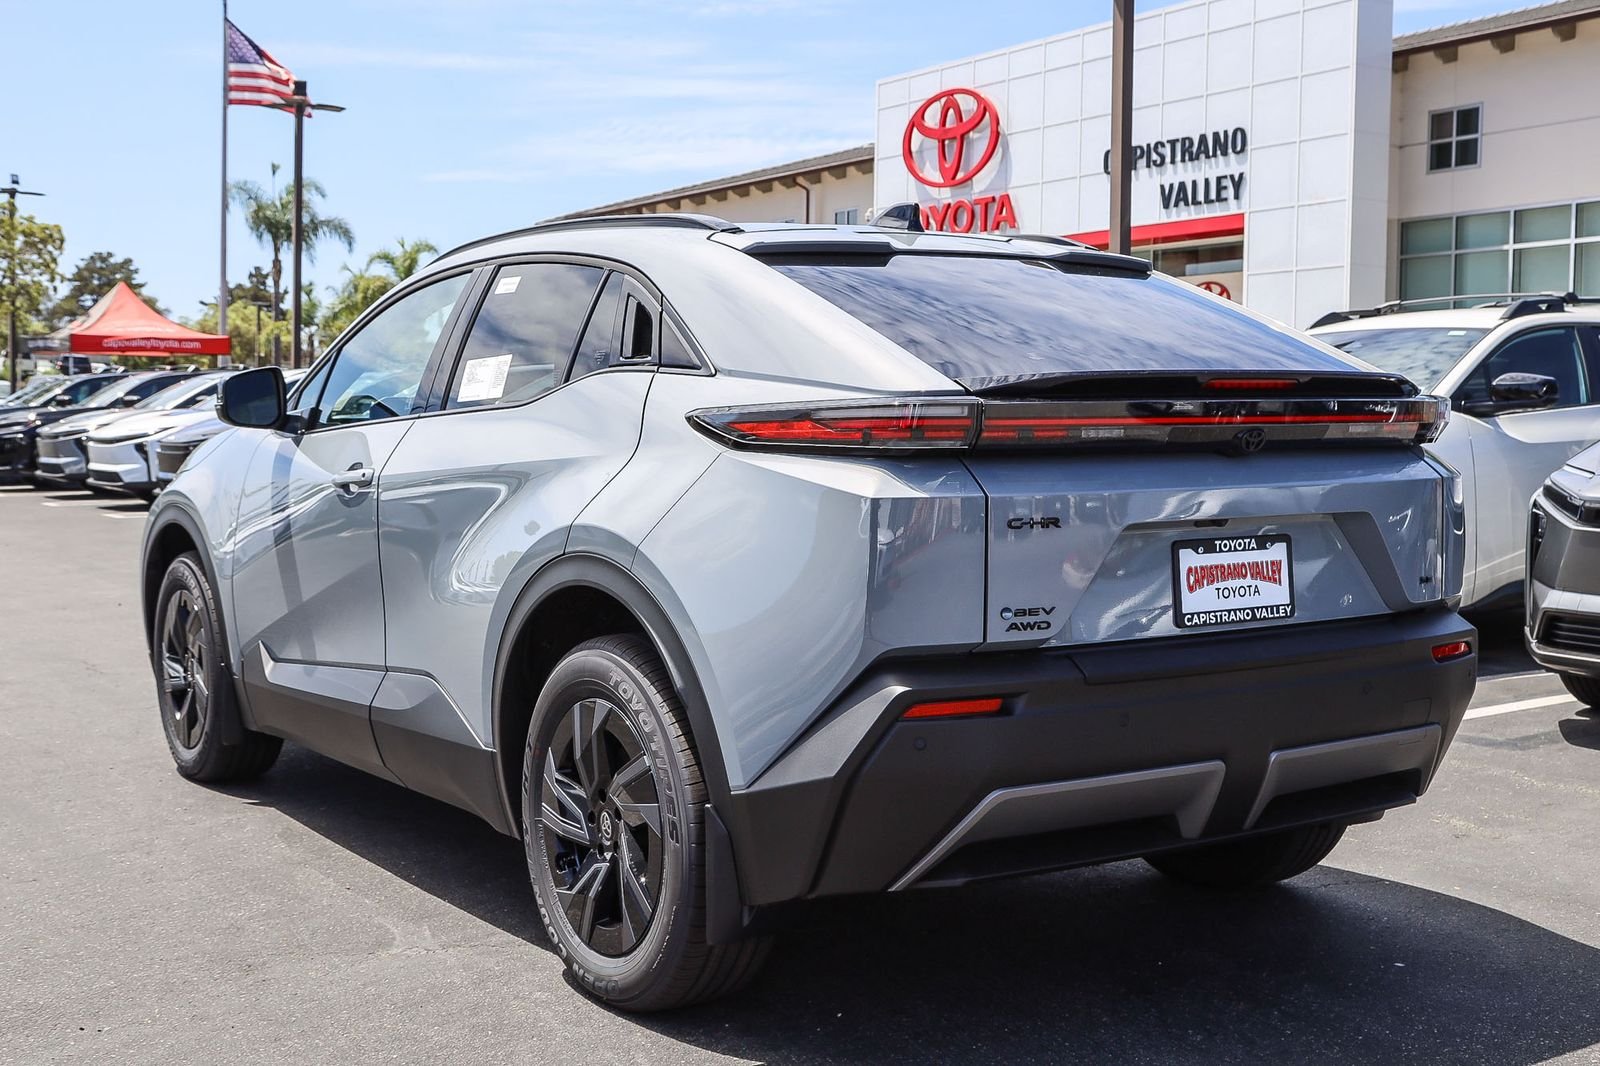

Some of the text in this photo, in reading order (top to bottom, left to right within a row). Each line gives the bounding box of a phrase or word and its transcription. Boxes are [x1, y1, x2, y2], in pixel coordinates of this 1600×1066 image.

[1103, 127, 1247, 175] CPISTRANO
[1160, 172, 1245, 209] VALLEY
[921, 193, 1017, 233] YOTA
[1006, 517, 1062, 530] C-HR
[1214, 538, 1257, 552] TOYOTA
[1186, 559, 1282, 594] CAPISTRANO VALLEY
[1215, 585, 1261, 600] TOYOTA
[1005, 620, 1052, 632] AWD
[1184, 605, 1292, 626] CAPISTRANO VALLEY
[609, 669, 653, 733] TOYO
